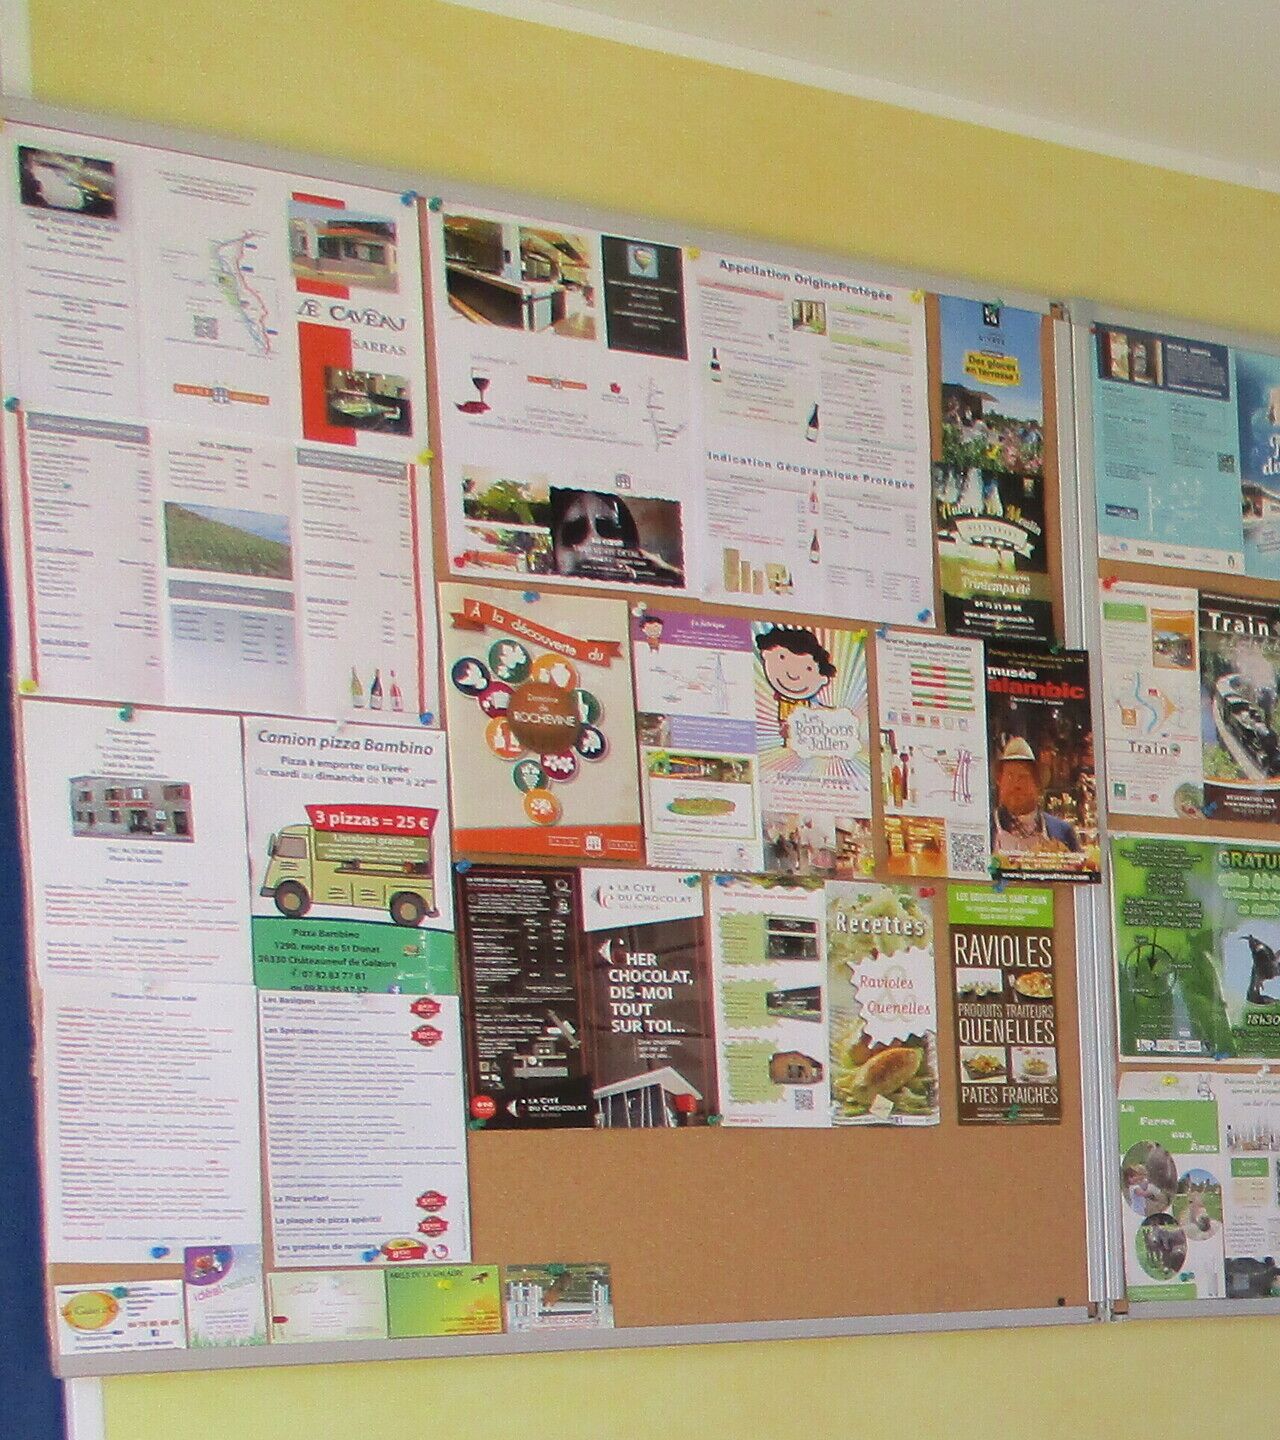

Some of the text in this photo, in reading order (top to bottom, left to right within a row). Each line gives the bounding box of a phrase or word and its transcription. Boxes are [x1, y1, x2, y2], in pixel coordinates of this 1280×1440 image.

[352, 339, 406, 356] SARRAS
[1208, 611, 1270, 637] Train
[510, 618, 577, 657] découverte
[987, 664, 1038, 681] musée
[987, 677, 1086, 700] alambic
[796, 719, 855, 737] Bonbons
[257, 729, 434, 756] Camion pizza Bambino
[1128, 739, 1168, 756] Train
[315, 772, 365, 784] dimanche
[315, 810, 326, 824] 3
[329, 811, 380, 828] pizzas
[396, 814, 417, 829] 25
[418, 816, 430, 831] €
[634, 893, 693, 903] CHOCOLAT
[835, 912, 926, 937] Recettes
[954, 932, 1053, 968] RAVIOLES
[608, 969, 694, 986] CHOCOLAT,
[859, 974, 914, 990] Ravioles
[609, 986, 674, 1001] DIS-MOI
[610, 1002, 653, 1017] TOUT
[866, 1000, 932, 1017] Quenelles
[957, 1002, 1054, 1019] PRODUITS TRAITEURS
[610, 1019, 686, 1034] SUR TOI...
[958, 1018, 1055, 1046] QUENELLES
[961, 1085, 1059, 1105] PATES FRAICHES
[541, 1104, 588, 1113] CHOCOLAT
